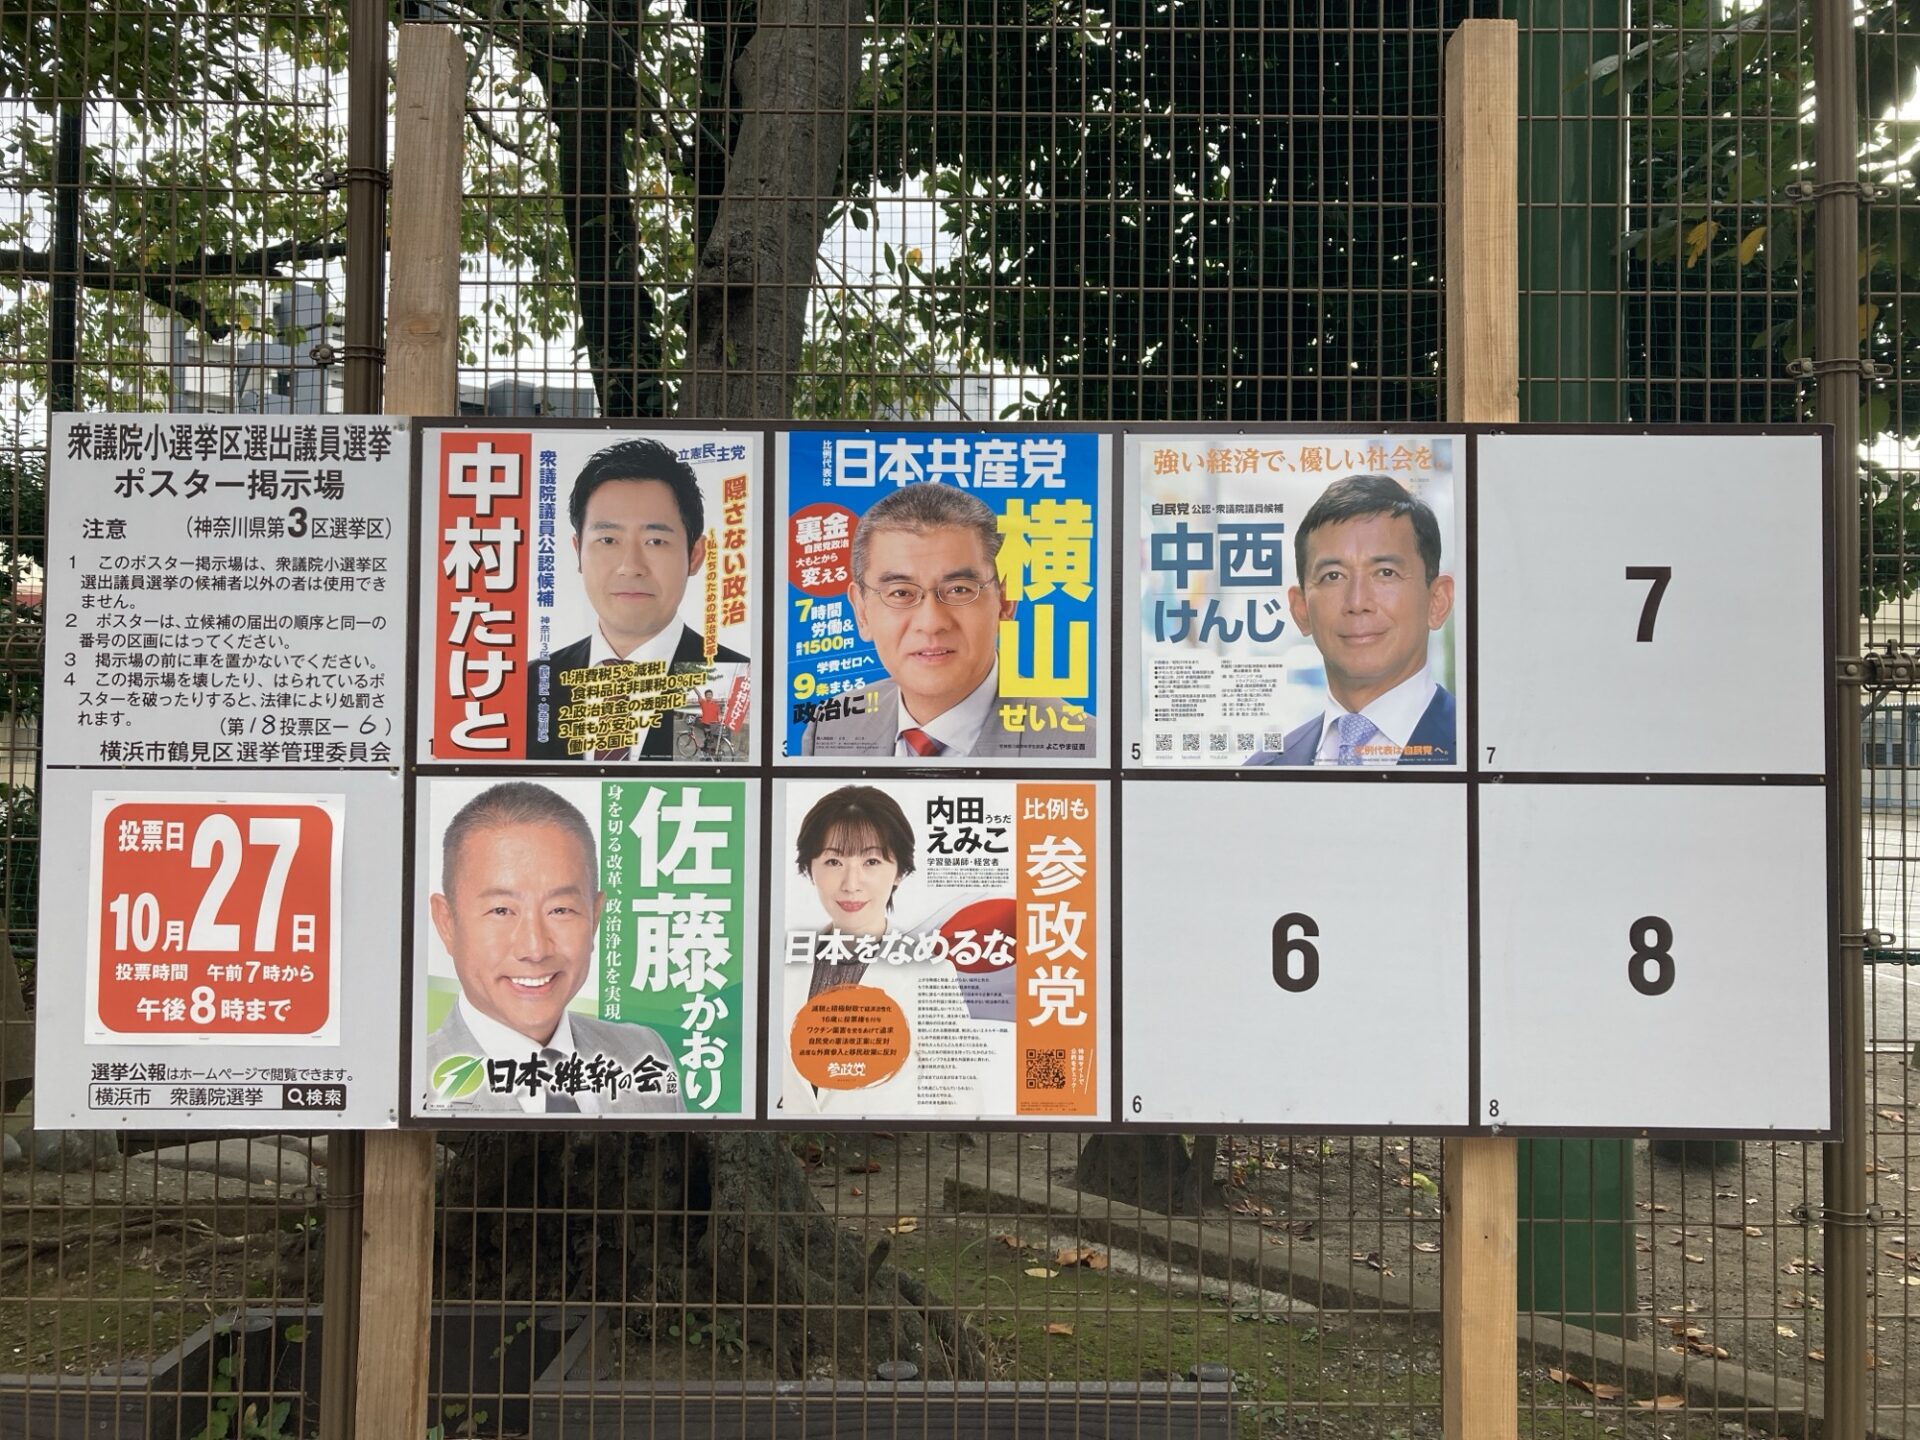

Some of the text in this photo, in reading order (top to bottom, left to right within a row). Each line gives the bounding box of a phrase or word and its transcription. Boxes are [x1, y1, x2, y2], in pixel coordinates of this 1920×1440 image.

[67, 424, 392, 462] 衆議院小選挙区選出議員選挙
[677, 443, 746, 462] 立憲民主党
[835, 438, 1066, 488] 日本共産党
[1153, 445, 1444, 474] 強い経済で、優しい社会を。
[114, 468, 345, 500] ポスター掲示場
[1151, 503, 1189, 515] 自民党
[82, 518, 127, 540] 注意
[536, 449, 557, 608] 衆議院議員公認候補
[795, 511, 850, 544] 裏金
[721, 473, 748, 627] 隠さない政治
[804, 538, 850, 554] 自民党政治
[1150, 522, 1285, 590] 中西
[69, 555, 388, 572] 1 このポスター掲示場は、衆議院小選挙区
[795, 552, 838, 568] 大もとから
[80, 574, 387, 592] 選出議員選挙の候補者以外の者は使用でき
[801, 566, 848, 588] 変える
[80, 594, 137, 610] ません。
[442, 441, 521, 751] 中村たけと
[995, 498, 1094, 698] 横山
[1626, 566, 1672, 642] 7
[65, 613, 387, 631] 2 ポスターは、立候補の届出の順序と同一の
[1154, 598, 1285, 643] けんじ
[78, 633, 291, 650] 番号の区画にはってください。
[63, 652, 378, 669] 3 掲示場の前に車を置かないでください。
[817, 655, 874, 674] 学費ゼロへ
[63, 672, 385, 689] 4 この掲示場を壊したり、はられているポ
[793, 673, 866, 699] 9条まもる
[78, 691, 386, 709] スターを破ったりすると、法律により処罰さ
[77, 711, 133, 727] れます。
[999, 704, 1086, 732] せいご
[99, 740, 392, 764] 横浜市鶴見区選挙管理委員会
[1131, 742, 1141, 760] 5
[1486, 747, 1496, 764] 7
[926, 796, 1012, 826] 内田 うちだ
[1023, 797, 1089, 821] 比例も
[118, 820, 185, 853] 投票日
[926, 826, 1010, 855] えみこ
[604, 784, 623, 1020] 身を切る改革、政治浄化を実現
[1025, 834, 1088, 1028] 参政党
[629, 786, 733, 1110] 佐藤かおり
[784, 928, 1017, 967] 日本をなめるな
[1272, 912, 1320, 993] 6
[1628, 915, 1676, 996] 8
[115, 960, 315, 984] 投票時間 午前7時から
[136, 985, 292, 1024] 午後8時まで
[91, 1062, 354, 1082] 選挙公報はホームページで閲覧できます。
[487, 1051, 669, 1100] 日本維新の会
[828, 1062, 866, 1078] 参政党
[666, 1071, 677, 1094] 公認
[95, 1086, 342, 1107] 横浜市 衆議院選挙 検索
[1132, 1096, 1142, 1113] 6
[1488, 1100, 1500, 1117] 8
